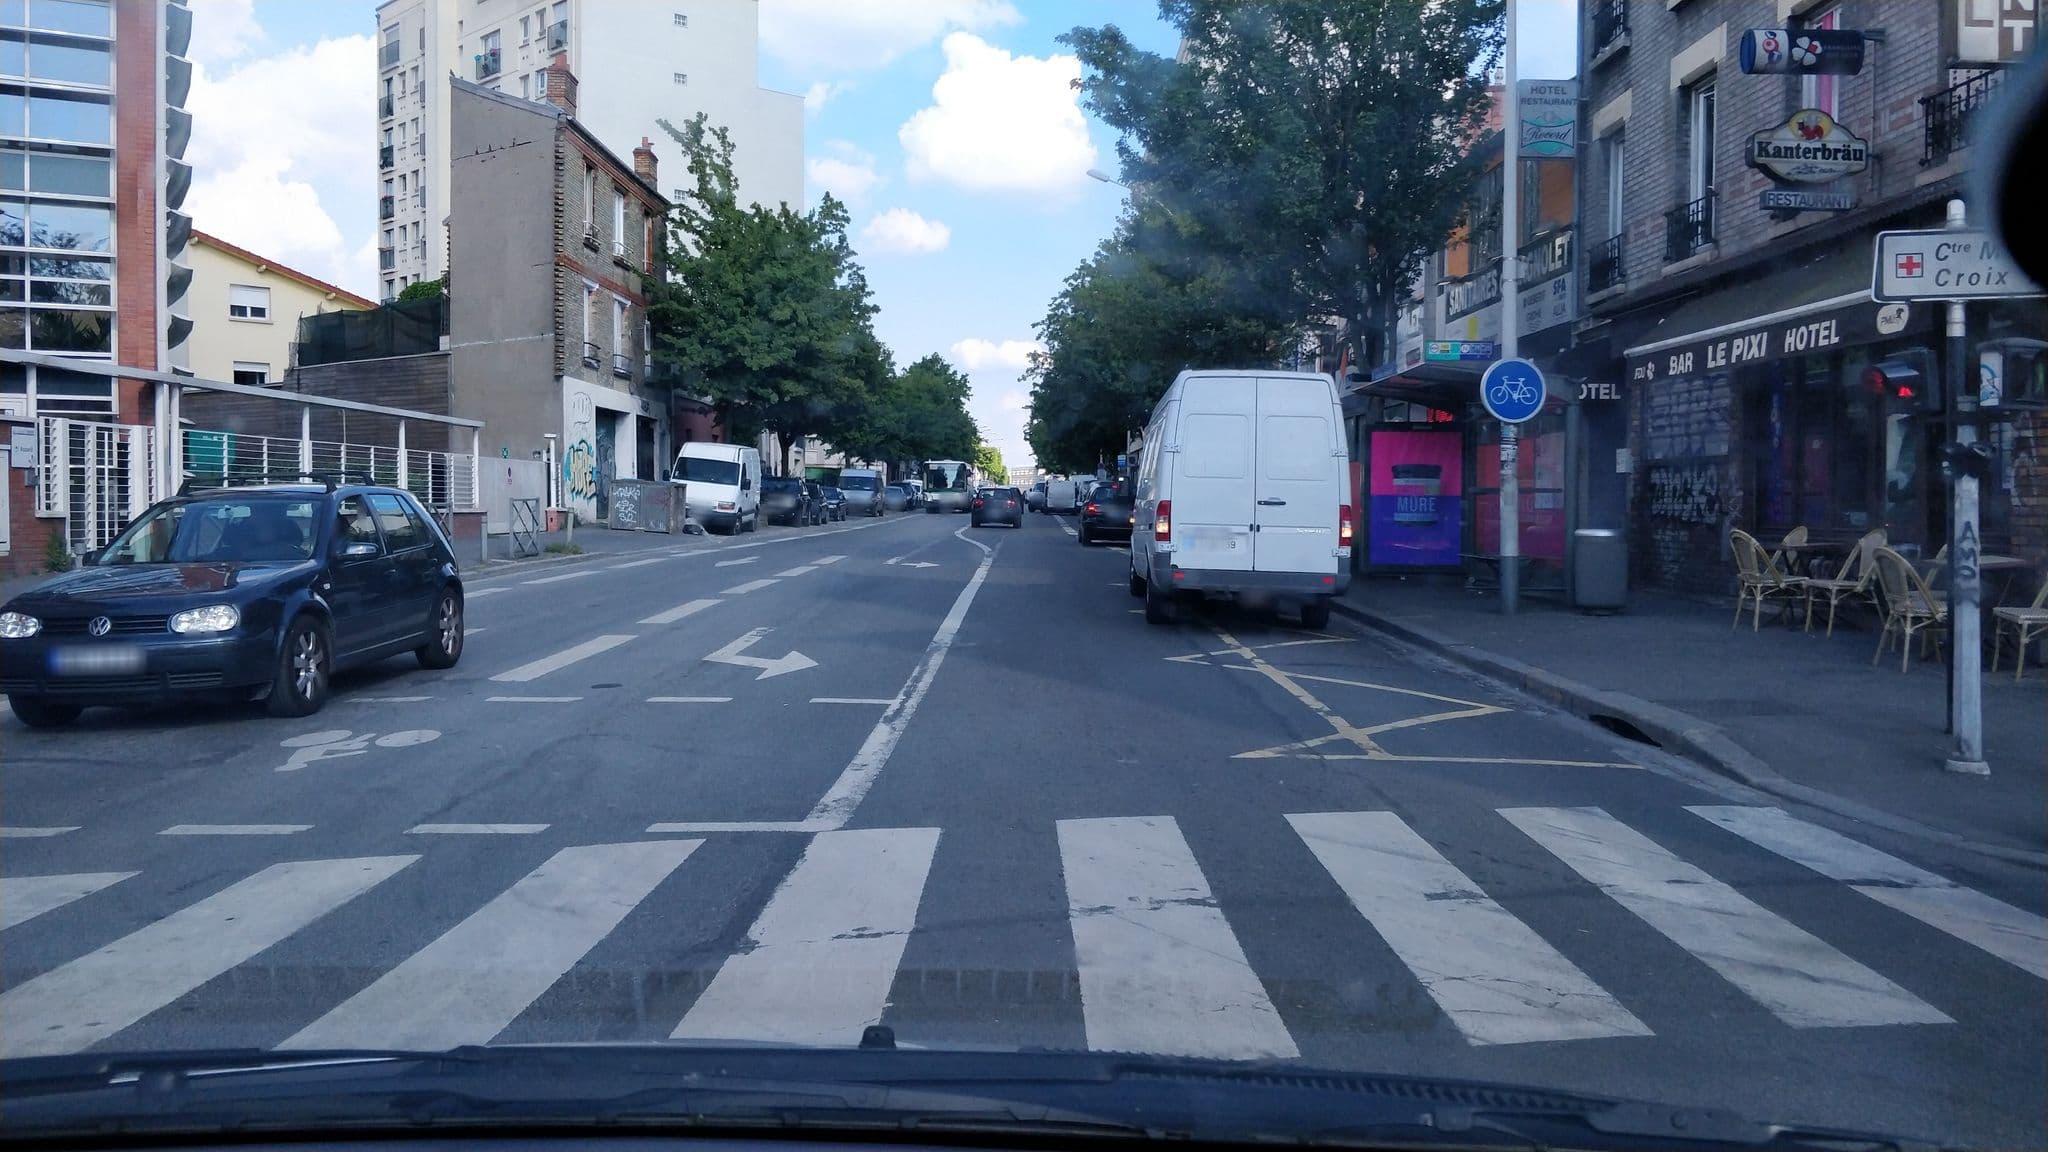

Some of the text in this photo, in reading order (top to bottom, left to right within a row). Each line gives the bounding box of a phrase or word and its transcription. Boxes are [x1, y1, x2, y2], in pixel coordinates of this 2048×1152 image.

[1530, 86, 1567, 95] HOTEL
[1756, 141, 1864, 161] Kanterbräu
[1767, 192, 1849, 208] RESTAURANT
[1935, 267, 2009, 287] Croix
[1668, 352, 1693, 376] BAR
[1707, 341, 1727, 369] LE
[1730, 331, 1768, 364] PIXI
[1784, 319, 1840, 354] HOTEL
[1578, 383, 1622, 400] OTEL
